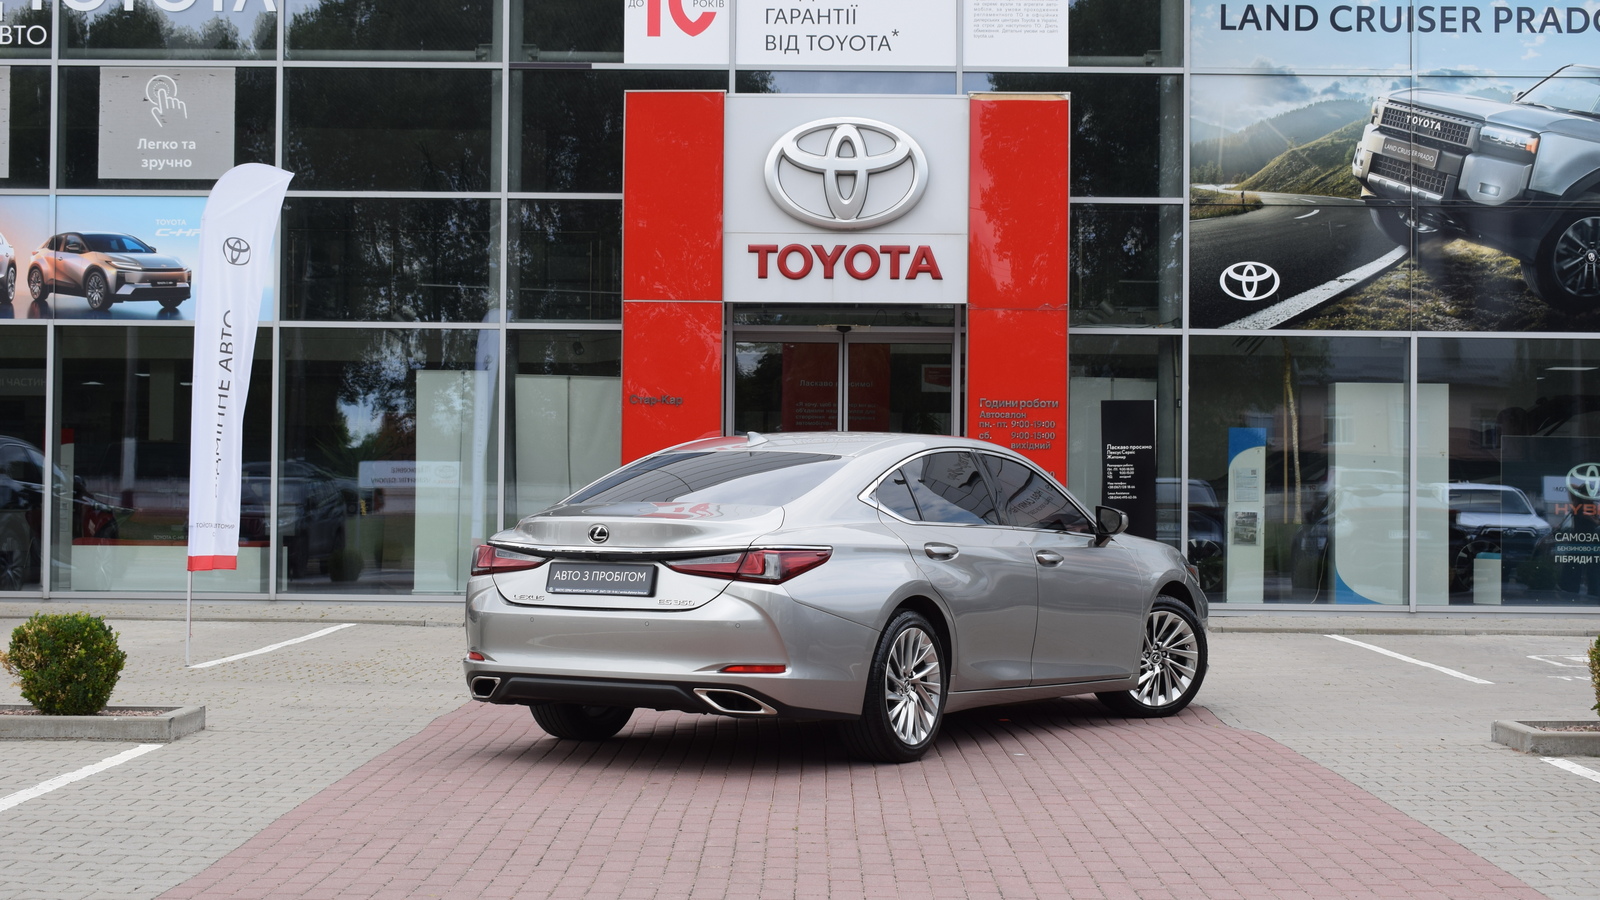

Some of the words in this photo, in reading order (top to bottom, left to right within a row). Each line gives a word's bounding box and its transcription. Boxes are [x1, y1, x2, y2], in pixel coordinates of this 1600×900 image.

[765, 4, 859, 25] ГАРАНТІЇ
[1220, 3, 1319, 32] LAND
[1329, 5, 1482, 34] CRUISER
[1493, 6, 1600, 34] PRAD
[765, 34, 800, 55] ВІД
[1406, 115, 1441, 131] TOYOTA
[137, 138, 179, 150] Легко
[182, 140, 197, 150] та
[141, 158, 193, 171] зручно
[155, 218, 187, 226] TOYOTA
[747, 243, 944, 281] TOYOTA
[799, 379, 834, 387] Ласкаво
[629, 394, 684, 406] Стар-Кар
[979, 397, 1019, 409] Години
[1019, 397, 1060, 410] роботи
[979, 410, 1027, 419] Автосалон
[1011, 420, 1055, 428] 9:00-19:00
[978, 431, 993, 440] сб.
[1011, 441, 1050, 450] вихідний
[1554, 503, 1600, 516] HYB
[1554, 555, 1593, 565] ГІБРИДИ
[553, 570, 581, 581] АВТО
[591, 571, 647, 583] ПРОБІГОМ
[657, 598, 673, 606] ES
[674, 599, 696, 607] 350
